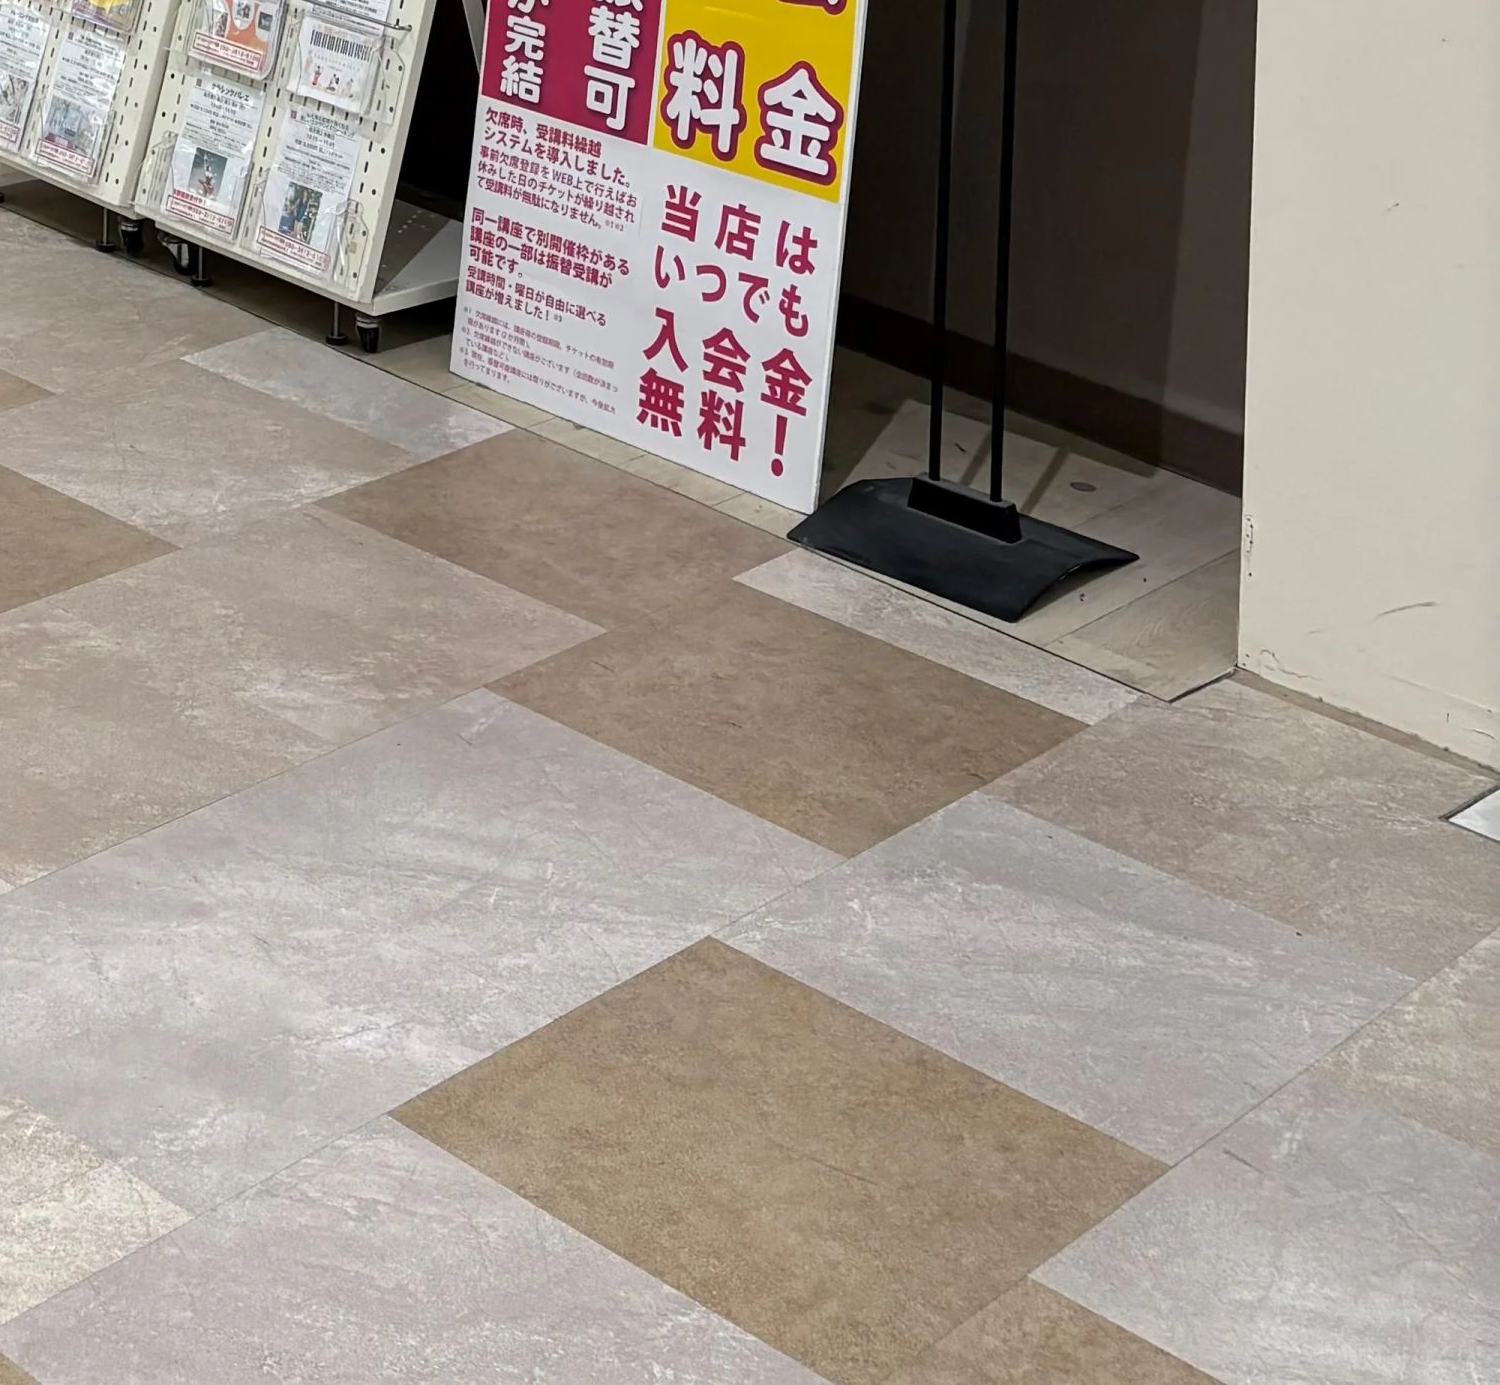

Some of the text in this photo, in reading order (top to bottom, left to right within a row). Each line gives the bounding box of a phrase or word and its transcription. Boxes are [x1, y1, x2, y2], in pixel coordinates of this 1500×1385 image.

[484, 127, 631, 189] システムを導入しました。
[485, 106, 602, 159] 欠席時、受講料繰越
[478, 160, 635, 224] 休みした日のチケットが繰り越され
[469, 244, 523, 278] 可能です。
[470, 225, 613, 289] 講座の一部は振替受講が
[471, 207, 630, 277] 同一講座で別開催枠がある
[661, 183, 819, 278] 当店は
[466, 281, 550, 321] 講座が増えました!
[467, 265, 607, 327] 受講時間・曜日が自由に選べる
[654, 245, 810, 338] いつでも
[643, 306, 813, 417] 入会金
